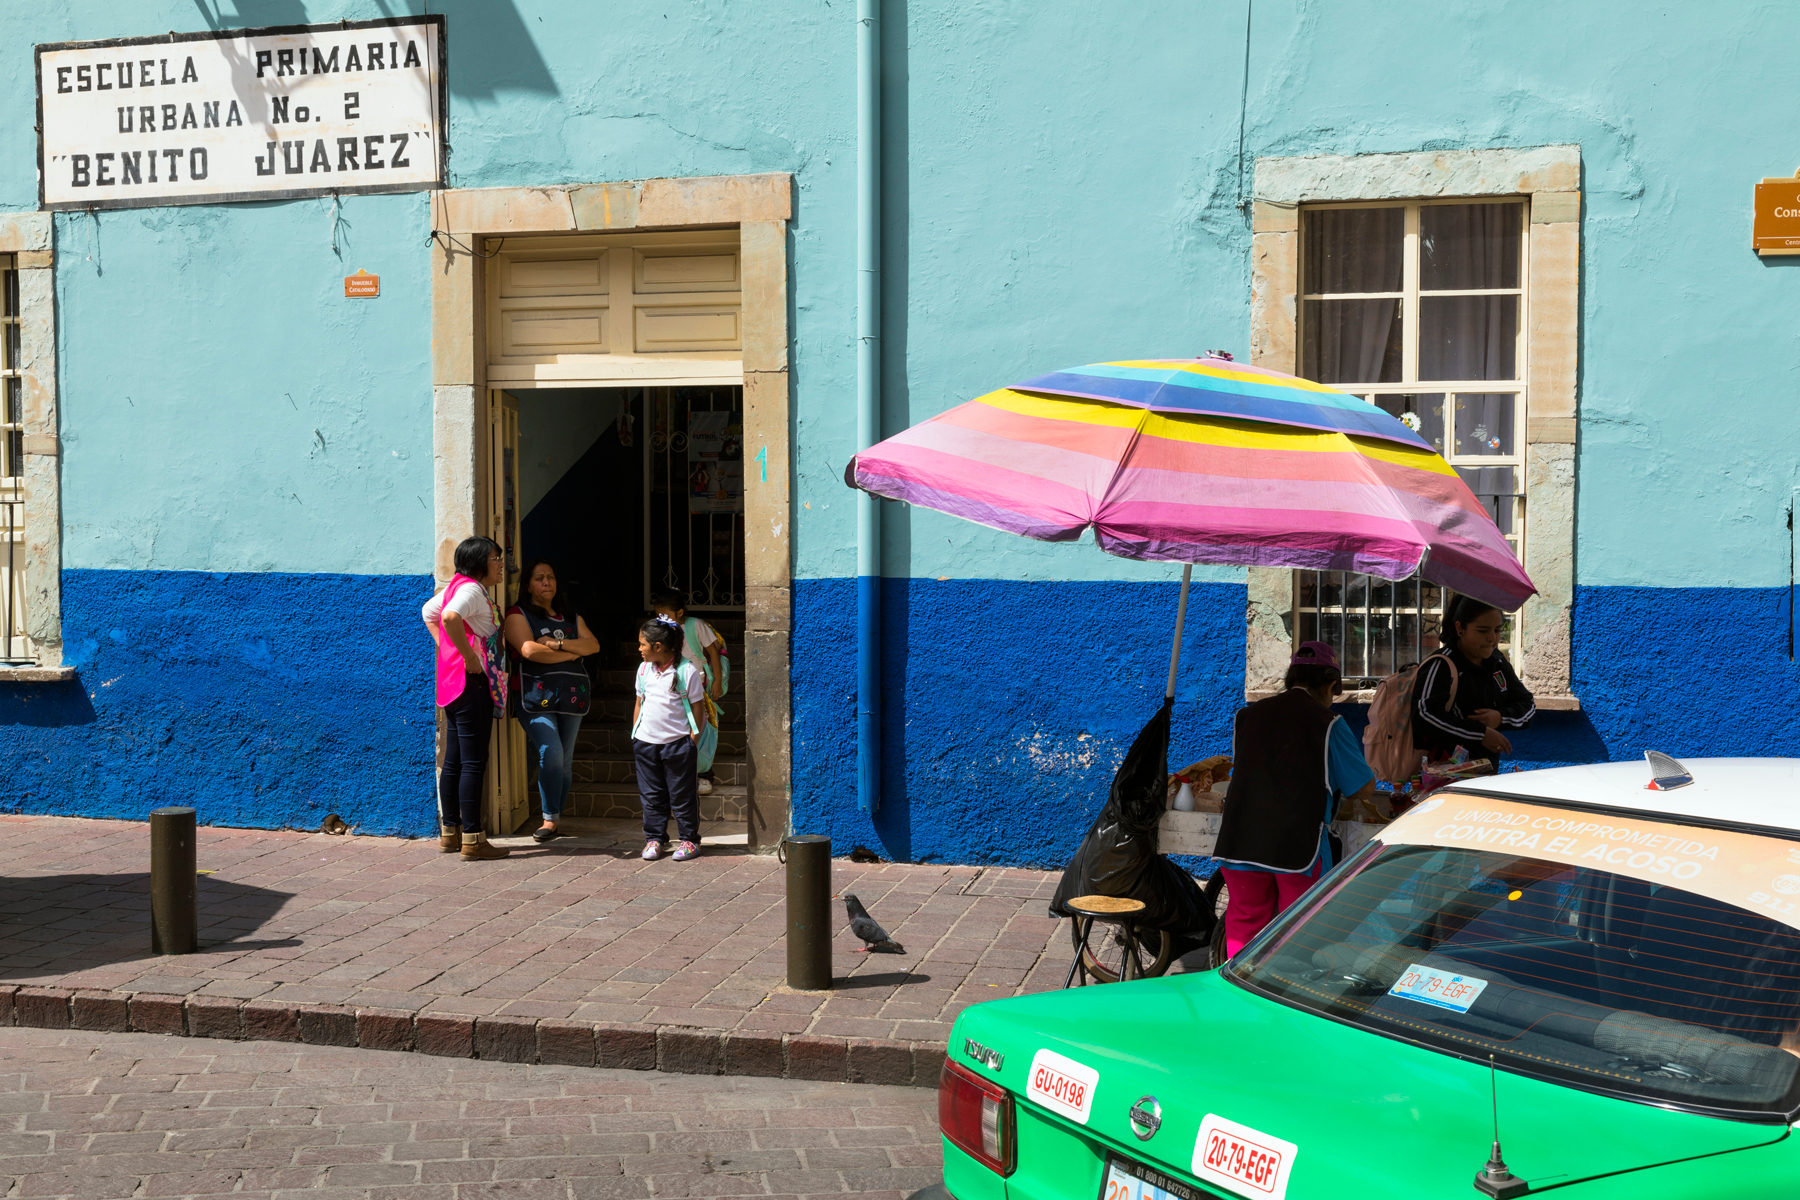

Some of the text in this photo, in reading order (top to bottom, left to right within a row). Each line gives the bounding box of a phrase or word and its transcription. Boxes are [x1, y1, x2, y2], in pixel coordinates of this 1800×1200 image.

[57, 39, 422, 94] ESCUELA PRIMARIA
[117, 91, 360, 134] URBANA No. 2
[754, 444, 767, 482] 1
[1433, 824, 1543, 849] CONTRA
[1543, 835, 1579, 856] EL
[1581, 843, 1703, 880] ACOSO
[1453, 809, 1720, 861] UNIDAD COMPROMETIDA
[1746, 891, 1796, 916] 911
[1399, 972, 1473, 999] 20-79-EGF
[964, 1037, 1005, 1072] TSURU
[1035, 1068, 1084, 1107] GU-0198
[1145, 1170, 1157, 1184] 800
[1207, 1135, 1277, 1186] 20-79-EGF
